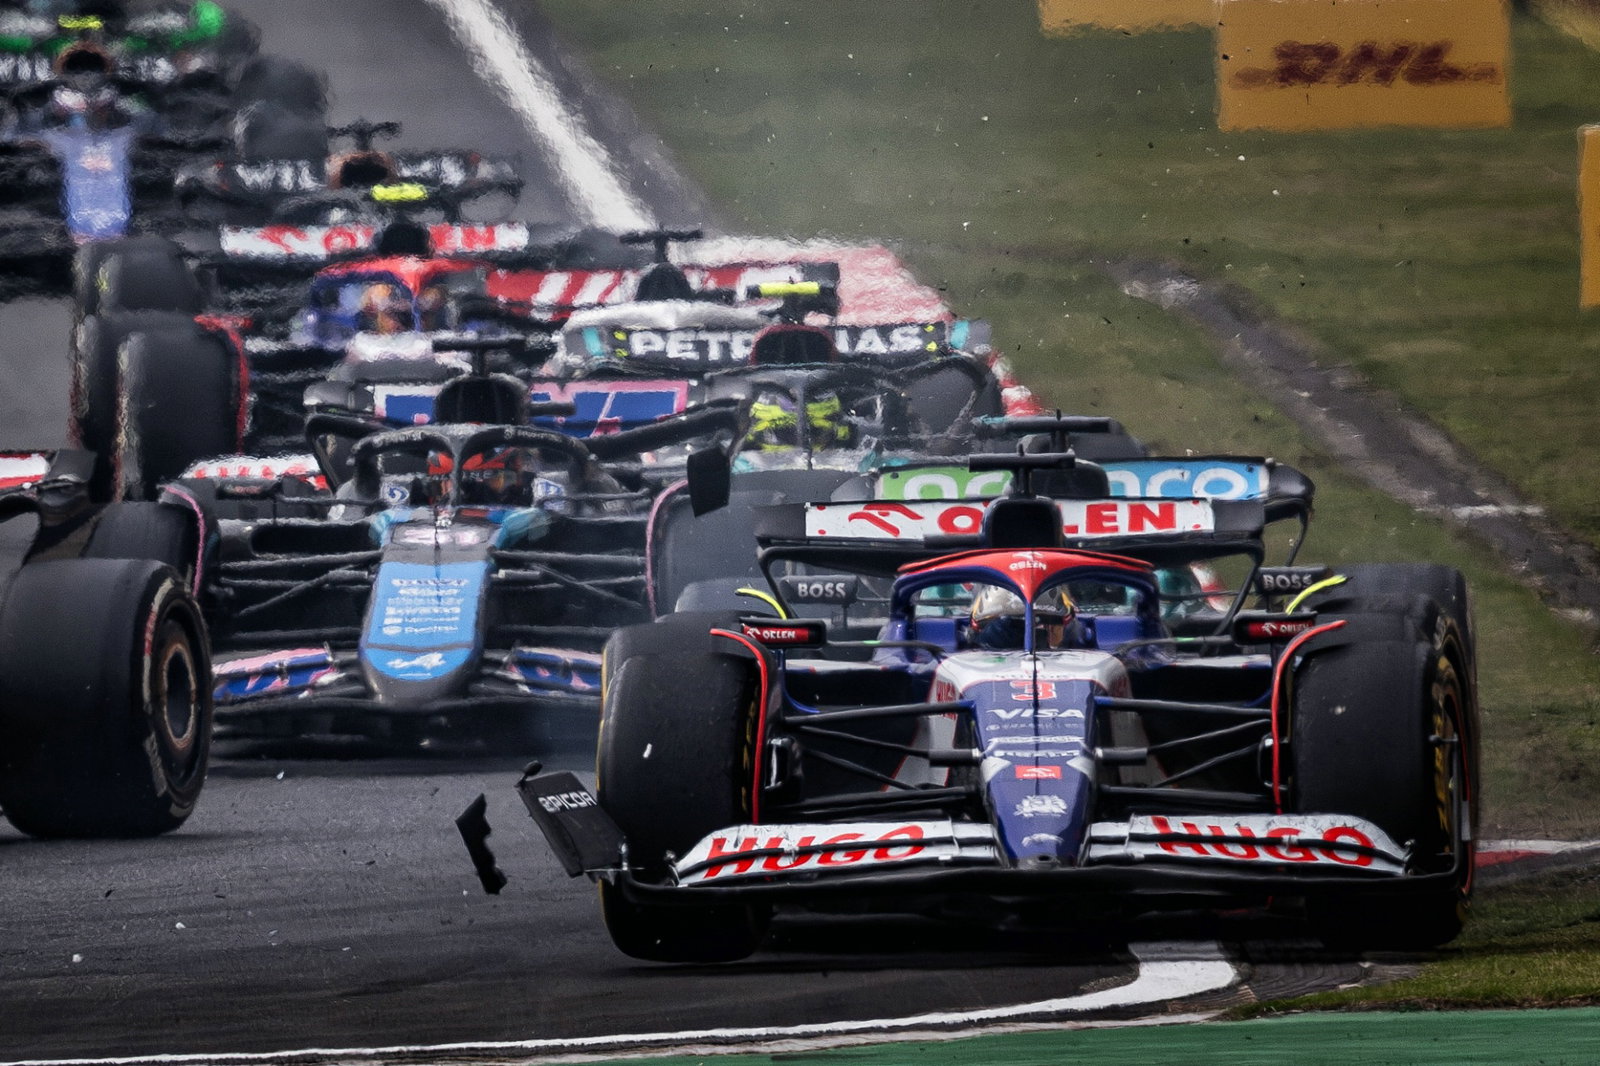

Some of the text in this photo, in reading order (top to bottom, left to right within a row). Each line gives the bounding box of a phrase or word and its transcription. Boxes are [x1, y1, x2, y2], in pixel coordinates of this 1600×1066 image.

[630, 325, 923, 361] PETRAS
[938, 502, 1177, 536] OEN
[797, 582, 847, 598] BOSS
[1009, 680, 1057, 701] 3
[985, 708, 1085, 719] VISA
[704, 825, 925, 879] HUGO
[1150, 815, 1375, 867] HUGO
